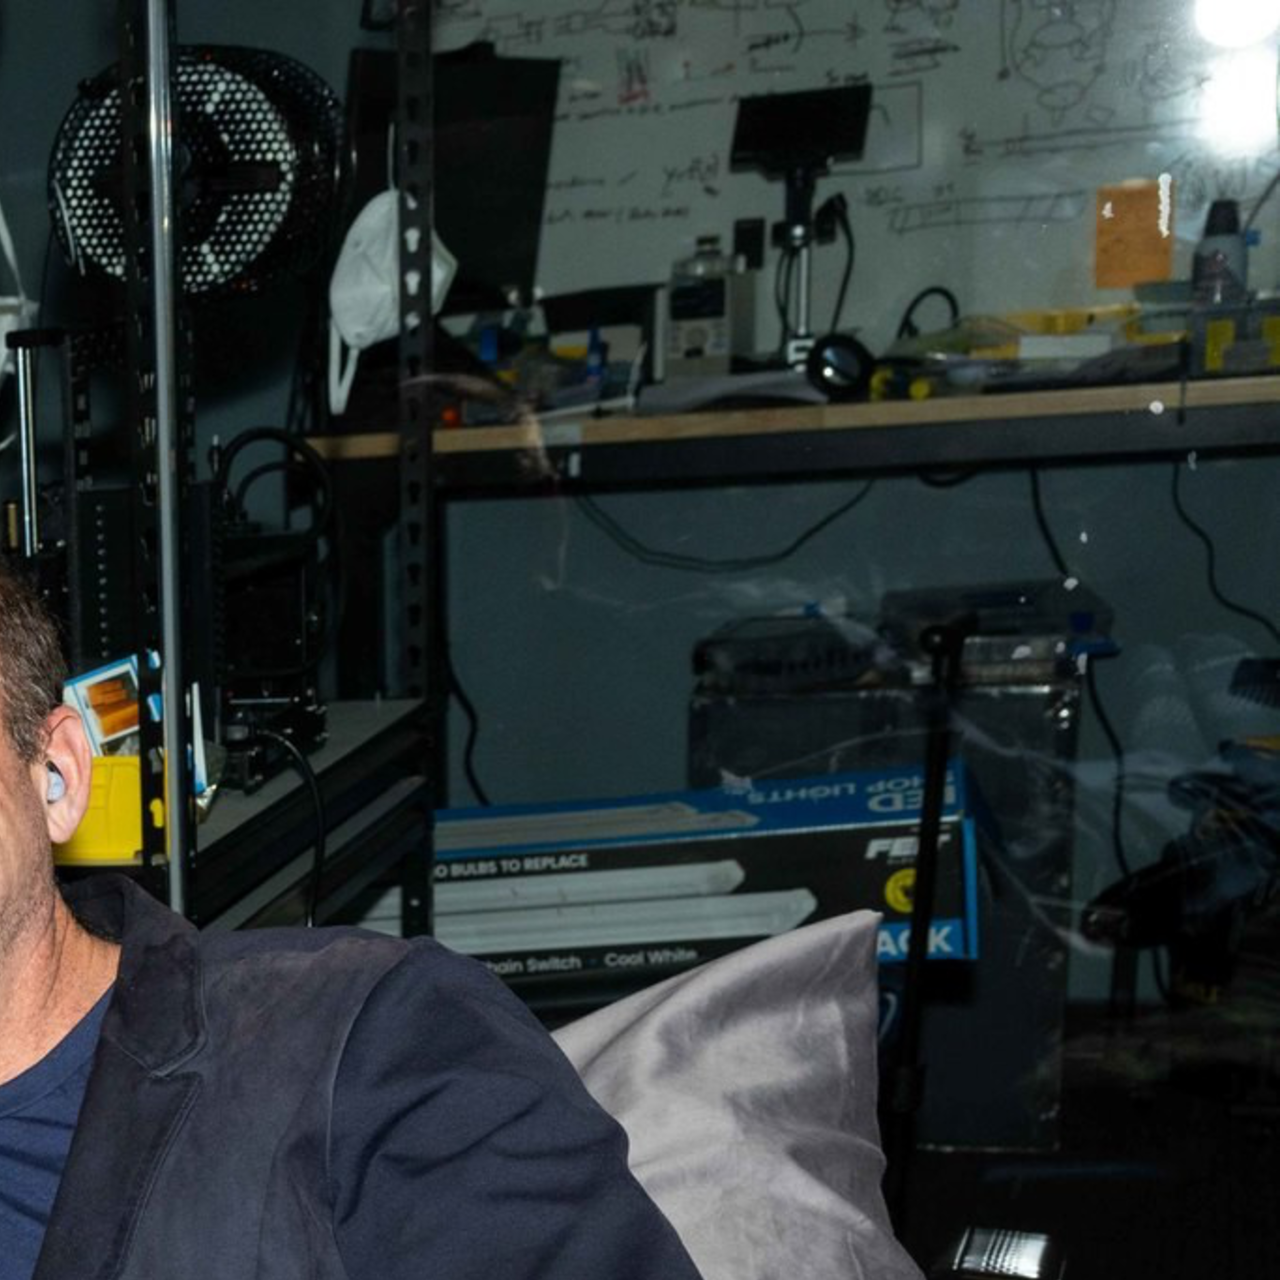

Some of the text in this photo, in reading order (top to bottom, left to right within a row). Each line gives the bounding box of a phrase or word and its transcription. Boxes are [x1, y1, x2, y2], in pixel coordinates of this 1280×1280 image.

[450, 859, 499, 878] BULBS
[500, 858, 521, 873] TO
[523, 852, 589, 872] REPLACE
[876, 924, 954, 957] ACK
[486, 945, 699, 976] hain Switch Cool White
